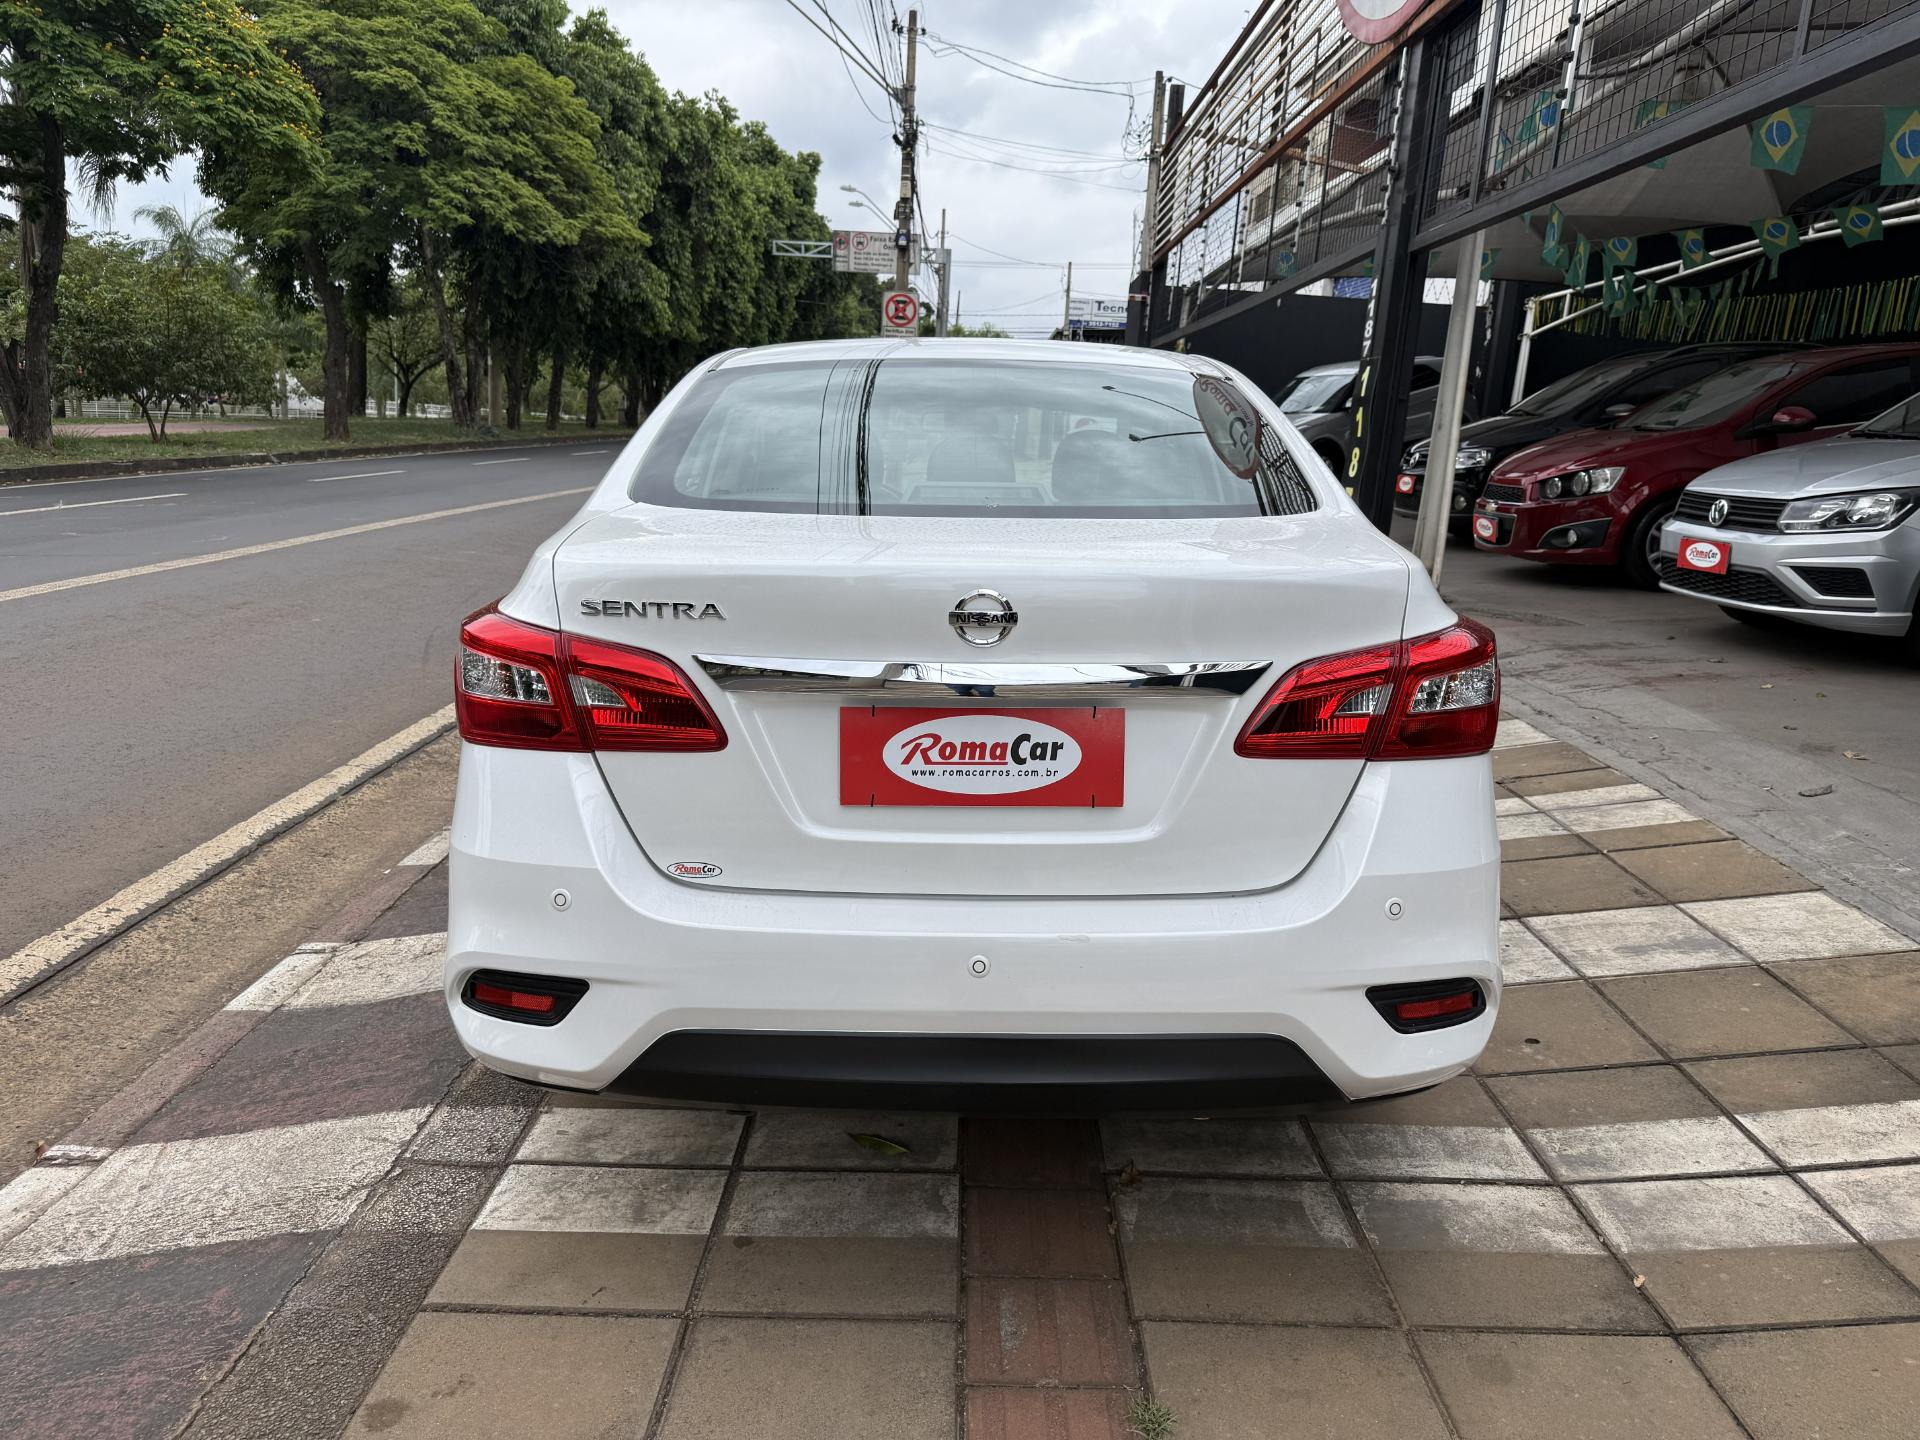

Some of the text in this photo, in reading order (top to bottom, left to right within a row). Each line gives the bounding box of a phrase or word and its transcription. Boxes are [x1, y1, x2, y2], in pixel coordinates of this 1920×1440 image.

[580, 599, 727, 620] SENTRA
[956, 611, 1012, 624] NISSAN
[901, 733, 1064, 766] RomaCar
[911, 768, 1059, 777] www.romacarros.com.br
[674, 864, 716, 874] RomaCar
